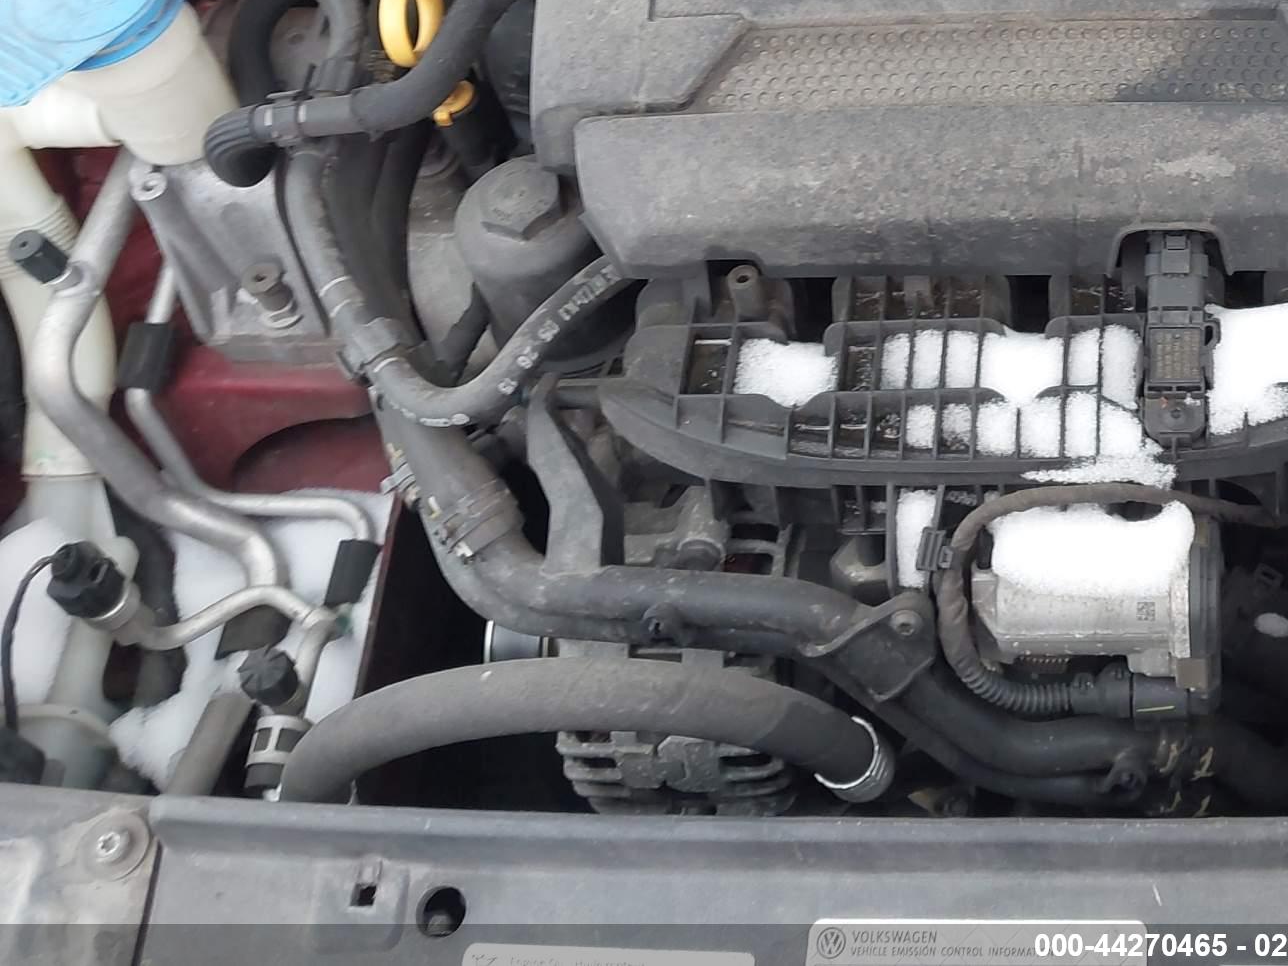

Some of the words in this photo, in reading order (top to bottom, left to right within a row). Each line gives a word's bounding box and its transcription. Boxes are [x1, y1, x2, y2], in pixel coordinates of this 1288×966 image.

[852, 930, 938, 944] VOLKSWAGEN
[851, 946, 887, 956] VEHICLE
[891, 945, 937, 957] EMISSION
[940, 945, 984, 957] CONTROL
